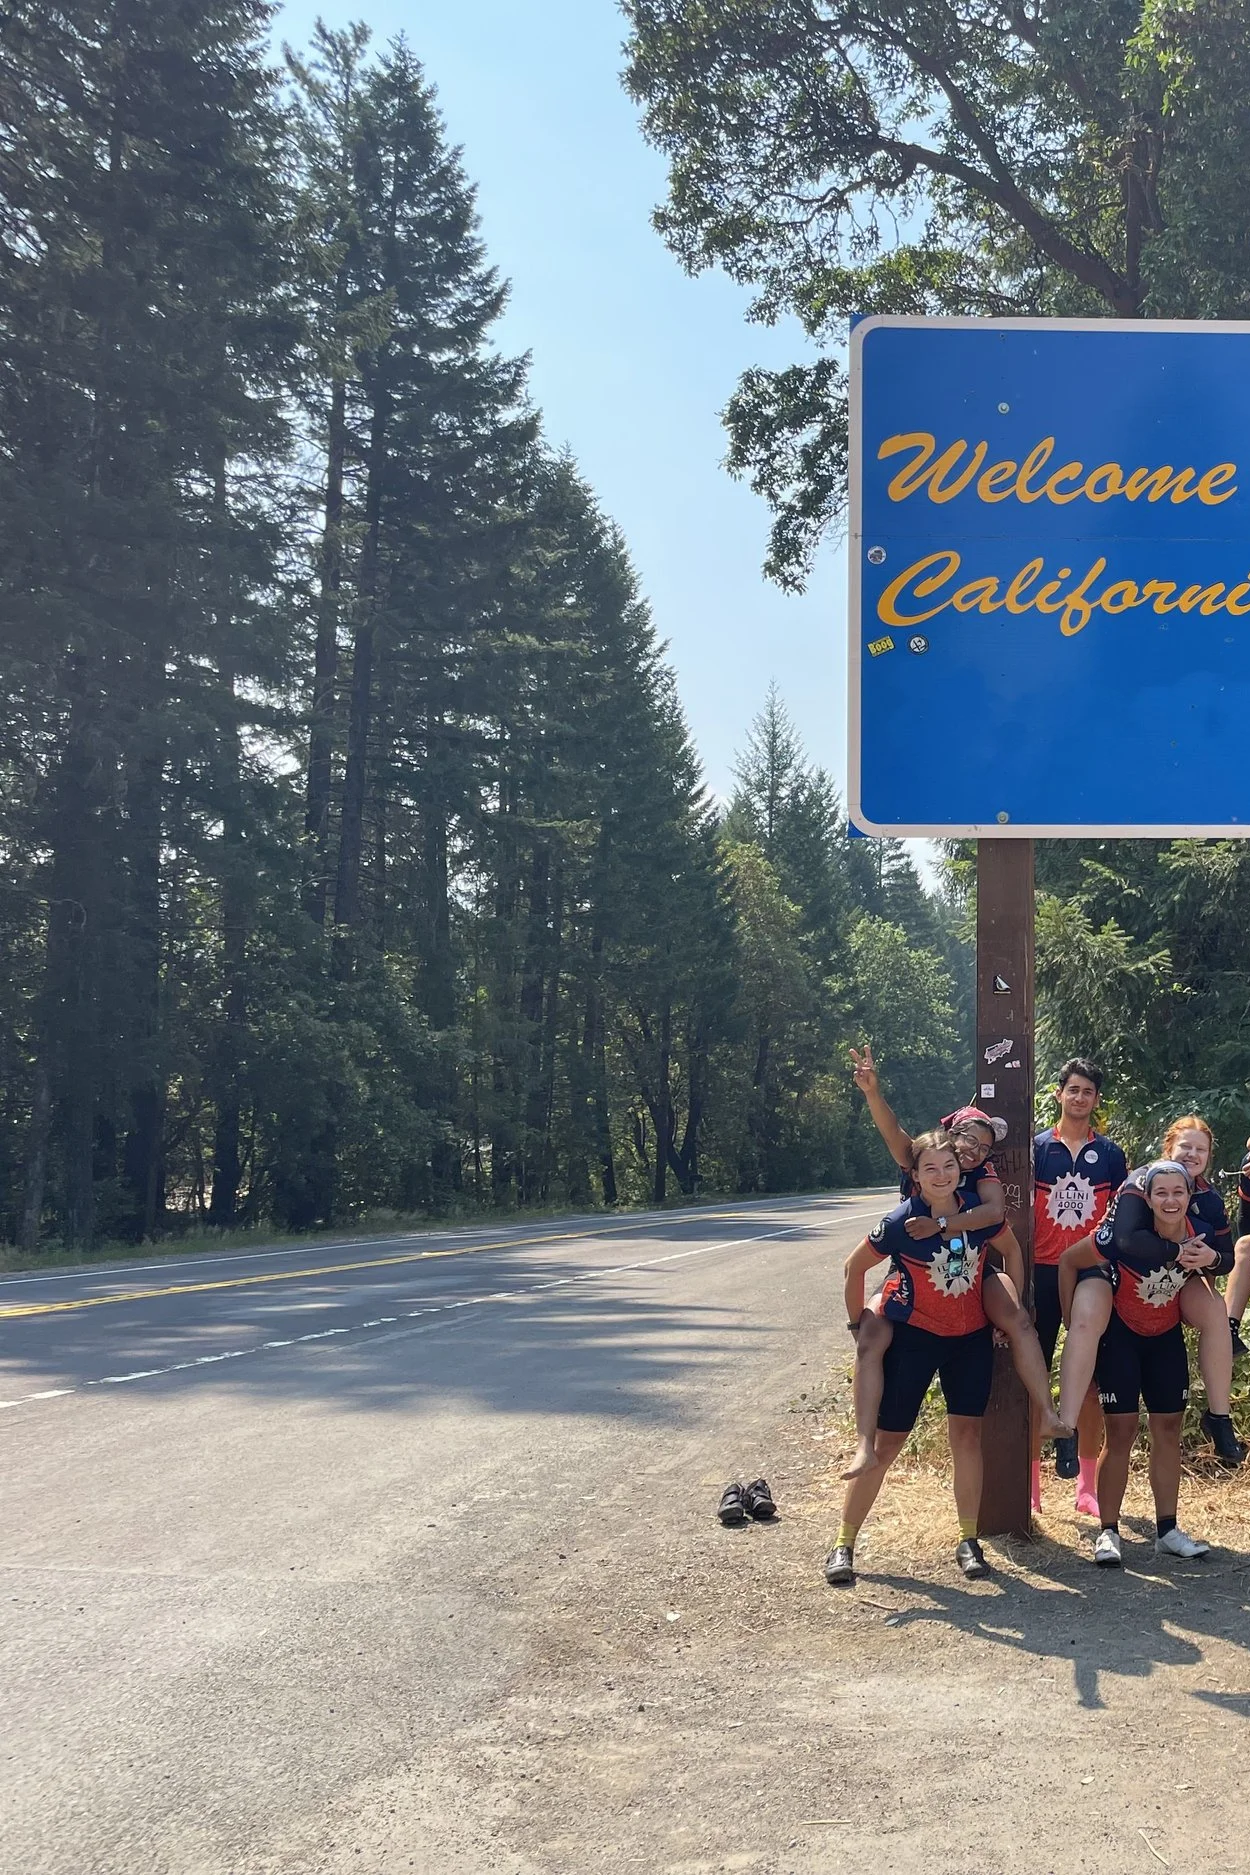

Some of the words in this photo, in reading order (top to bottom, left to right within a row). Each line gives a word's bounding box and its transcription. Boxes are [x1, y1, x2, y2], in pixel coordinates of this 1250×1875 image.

[878, 432, 1238, 504] Welcome
[1055, 1191, 1089, 1201] ILLINI
[1057, 1201, 1084, 1210] 4000
[936, 1261, 975, 1273] ILNI
[1146, 1283, 1181, 1291] ILLINI
